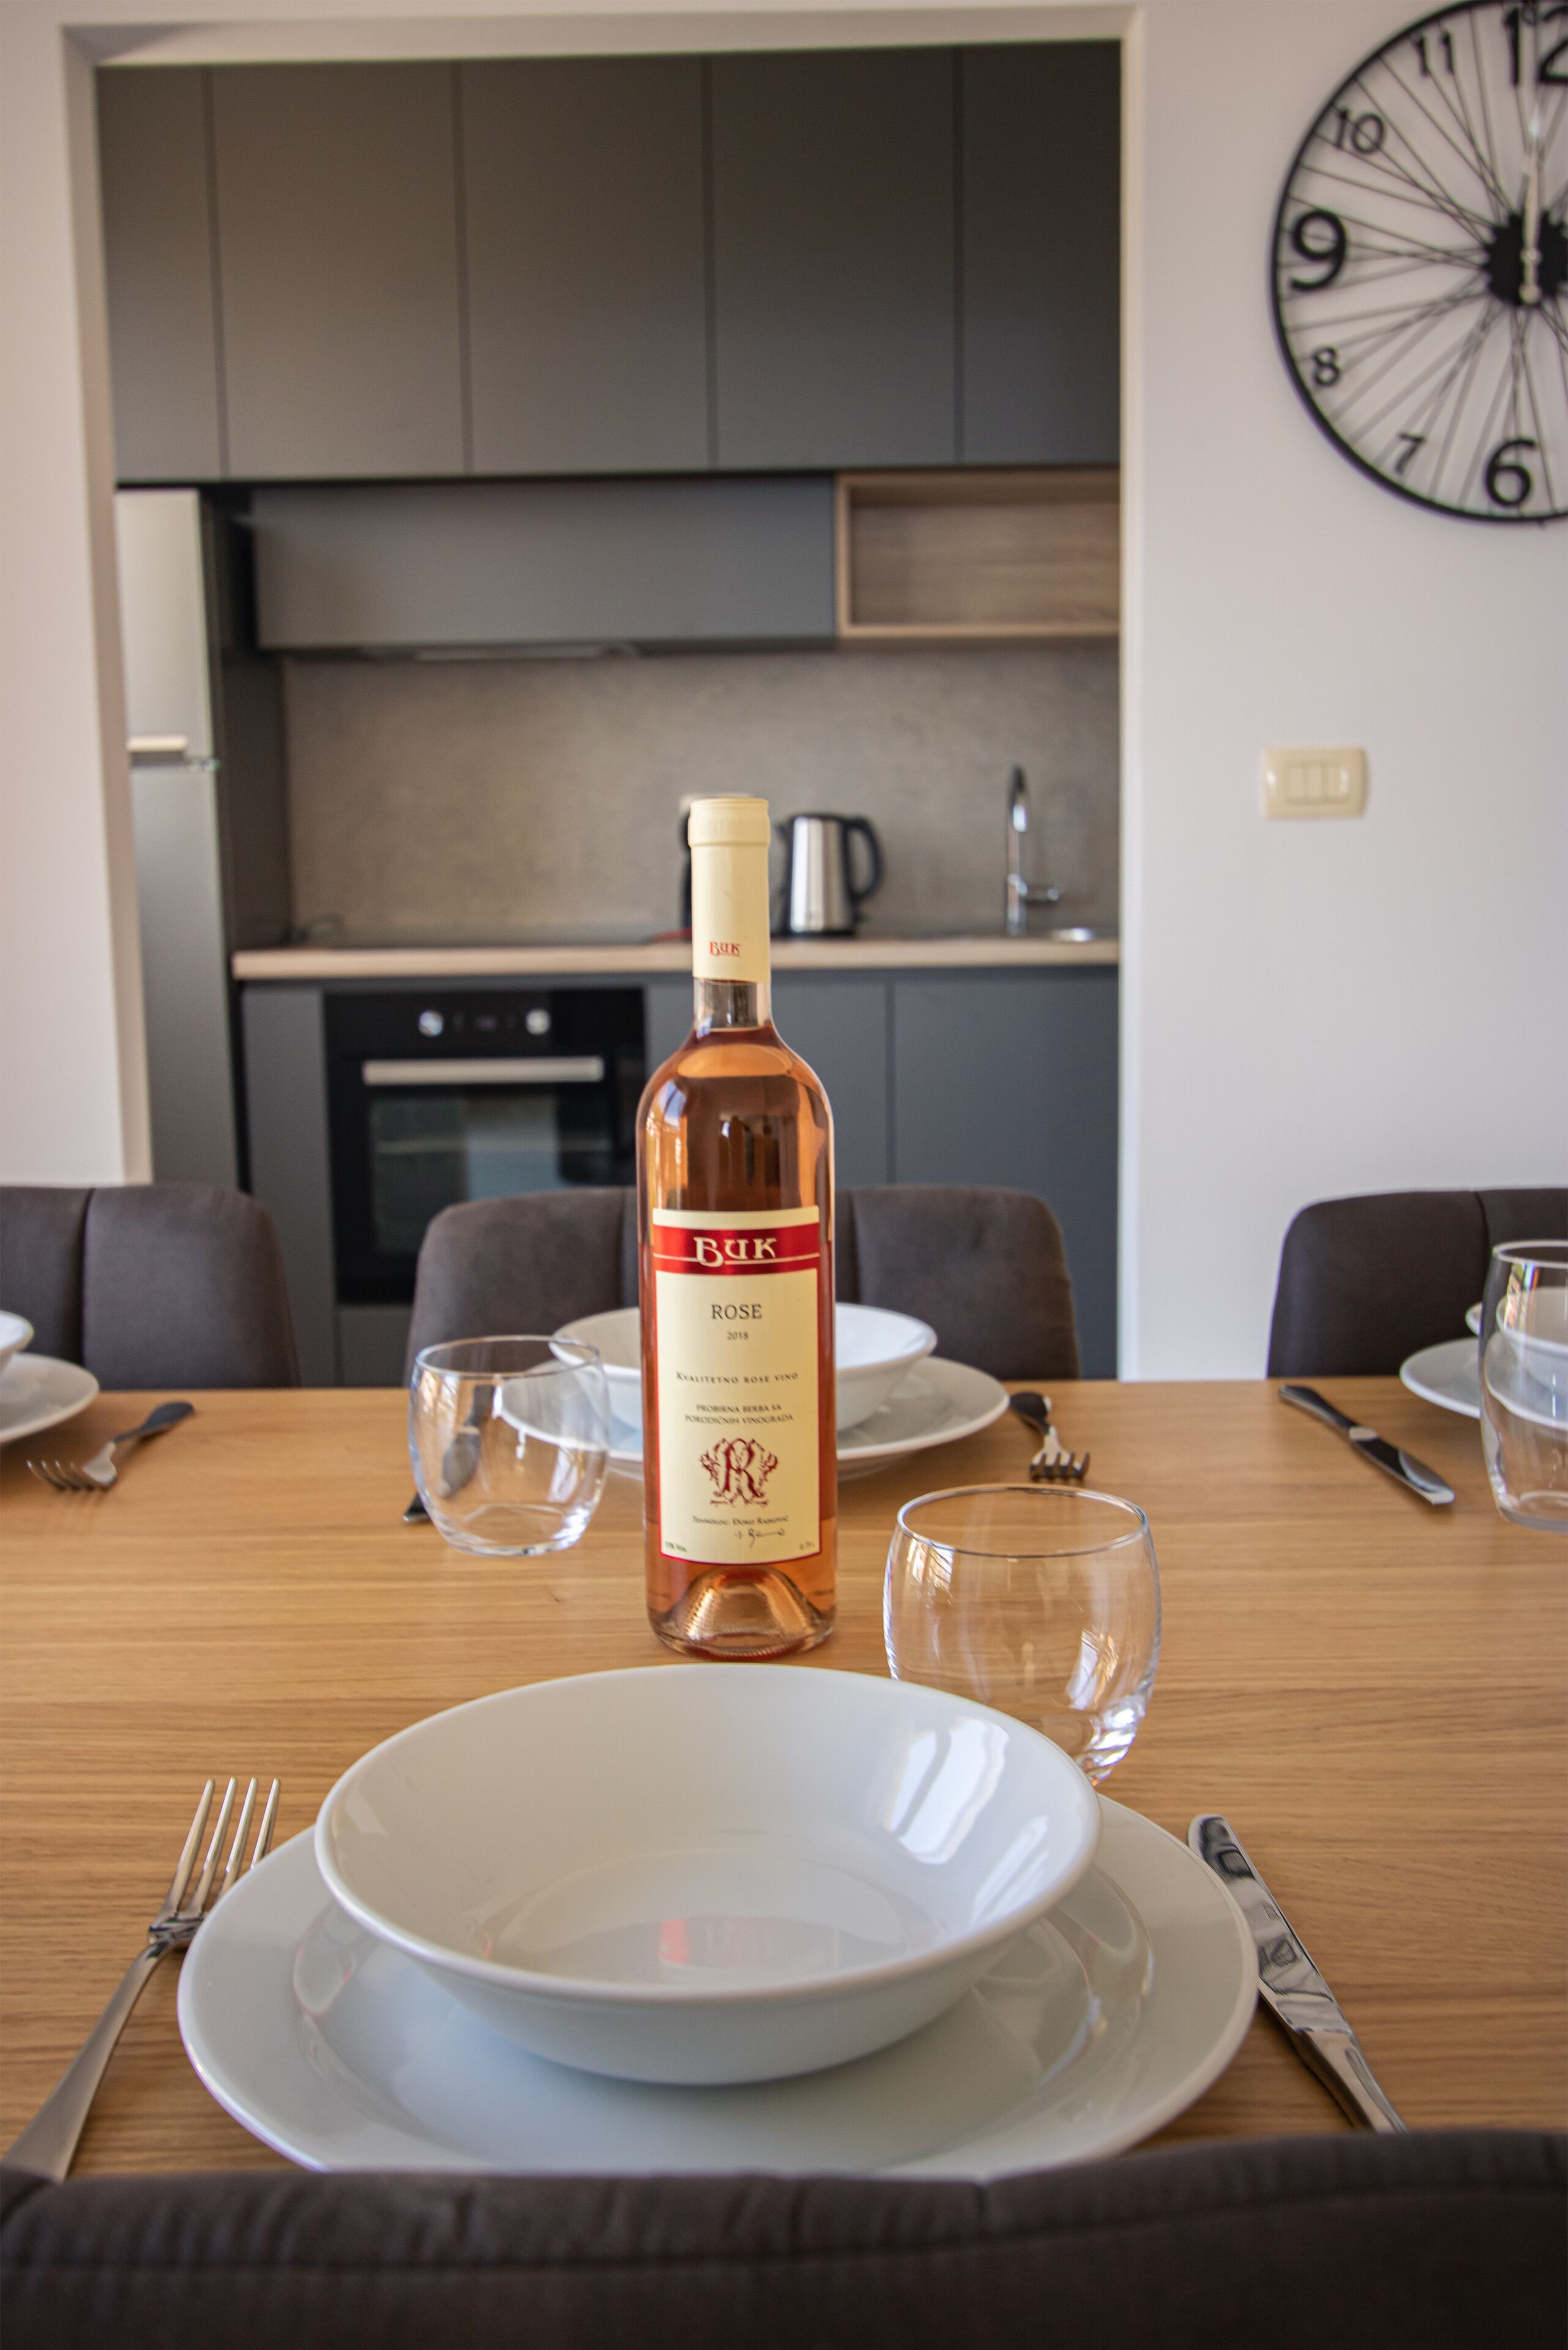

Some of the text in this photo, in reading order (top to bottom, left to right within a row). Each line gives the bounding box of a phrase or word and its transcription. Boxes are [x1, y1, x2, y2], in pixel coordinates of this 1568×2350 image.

[1413, 30, 1455, 77] 11
[1334, 108, 1386, 155] 10
[1290, 211, 1347, 290] 9
[1312, 347, 1342, 387] 8
[1398, 432, 1427, 474] 7
[1485, 438, 1537, 507] 6
[711, 1304, 763, 1319] ROSE
[726, 1332, 749, 1340] 2018
[774, 1372, 798, 1381] VINO
